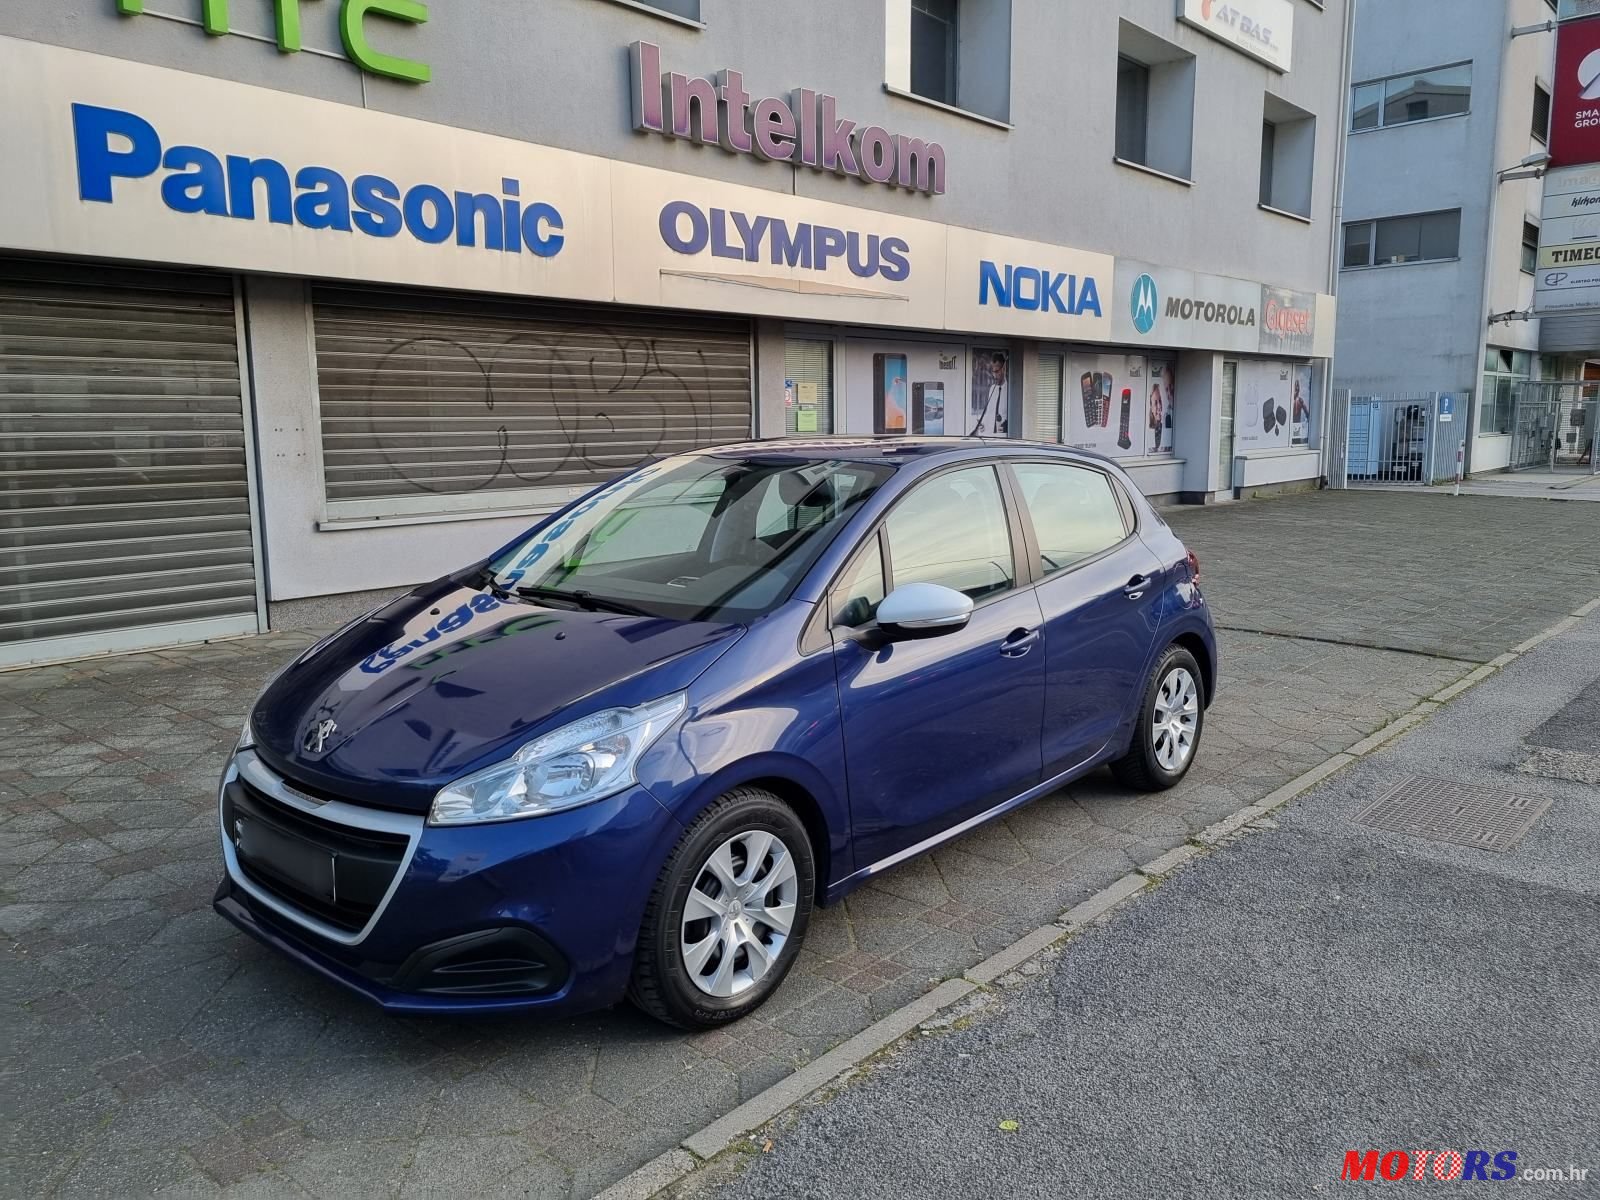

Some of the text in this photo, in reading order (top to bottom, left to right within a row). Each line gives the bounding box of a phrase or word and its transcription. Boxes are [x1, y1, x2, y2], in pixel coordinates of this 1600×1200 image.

[630, 40, 947, 195] Intelkom
[1575, 108, 1600, 119] SMA
[71, 102, 564, 258] Panasonic
[659, 201, 910, 281] OLYMPUS
[979, 260, 1102, 318] NOKIA
[1165, 297, 1255, 327] MOTOROLA
